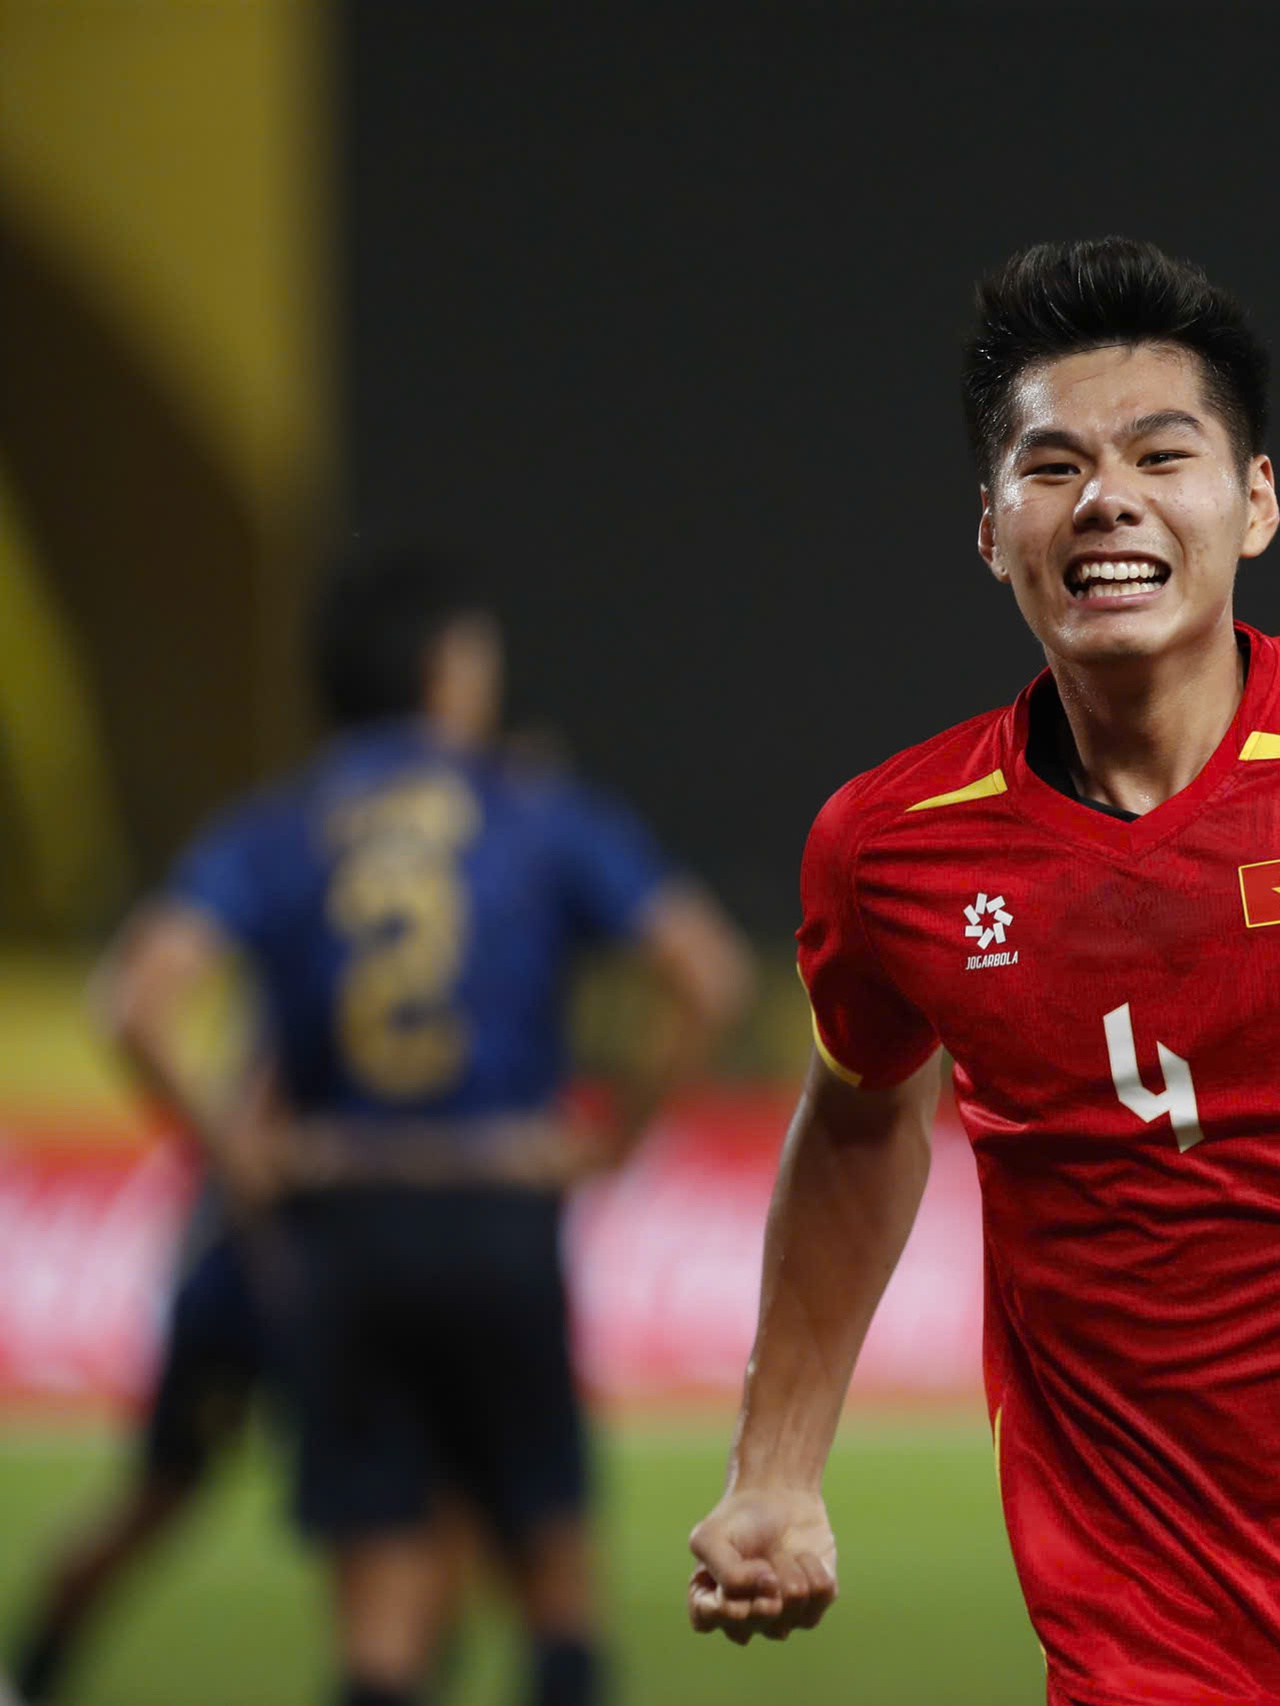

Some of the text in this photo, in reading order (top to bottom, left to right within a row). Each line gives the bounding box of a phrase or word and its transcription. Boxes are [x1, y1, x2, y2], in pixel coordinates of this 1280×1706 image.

[330, 852, 468, 1096] 2
[965, 950, 1019, 971] JOGARBOLA
[1103, 1002, 1205, 1153] 4
